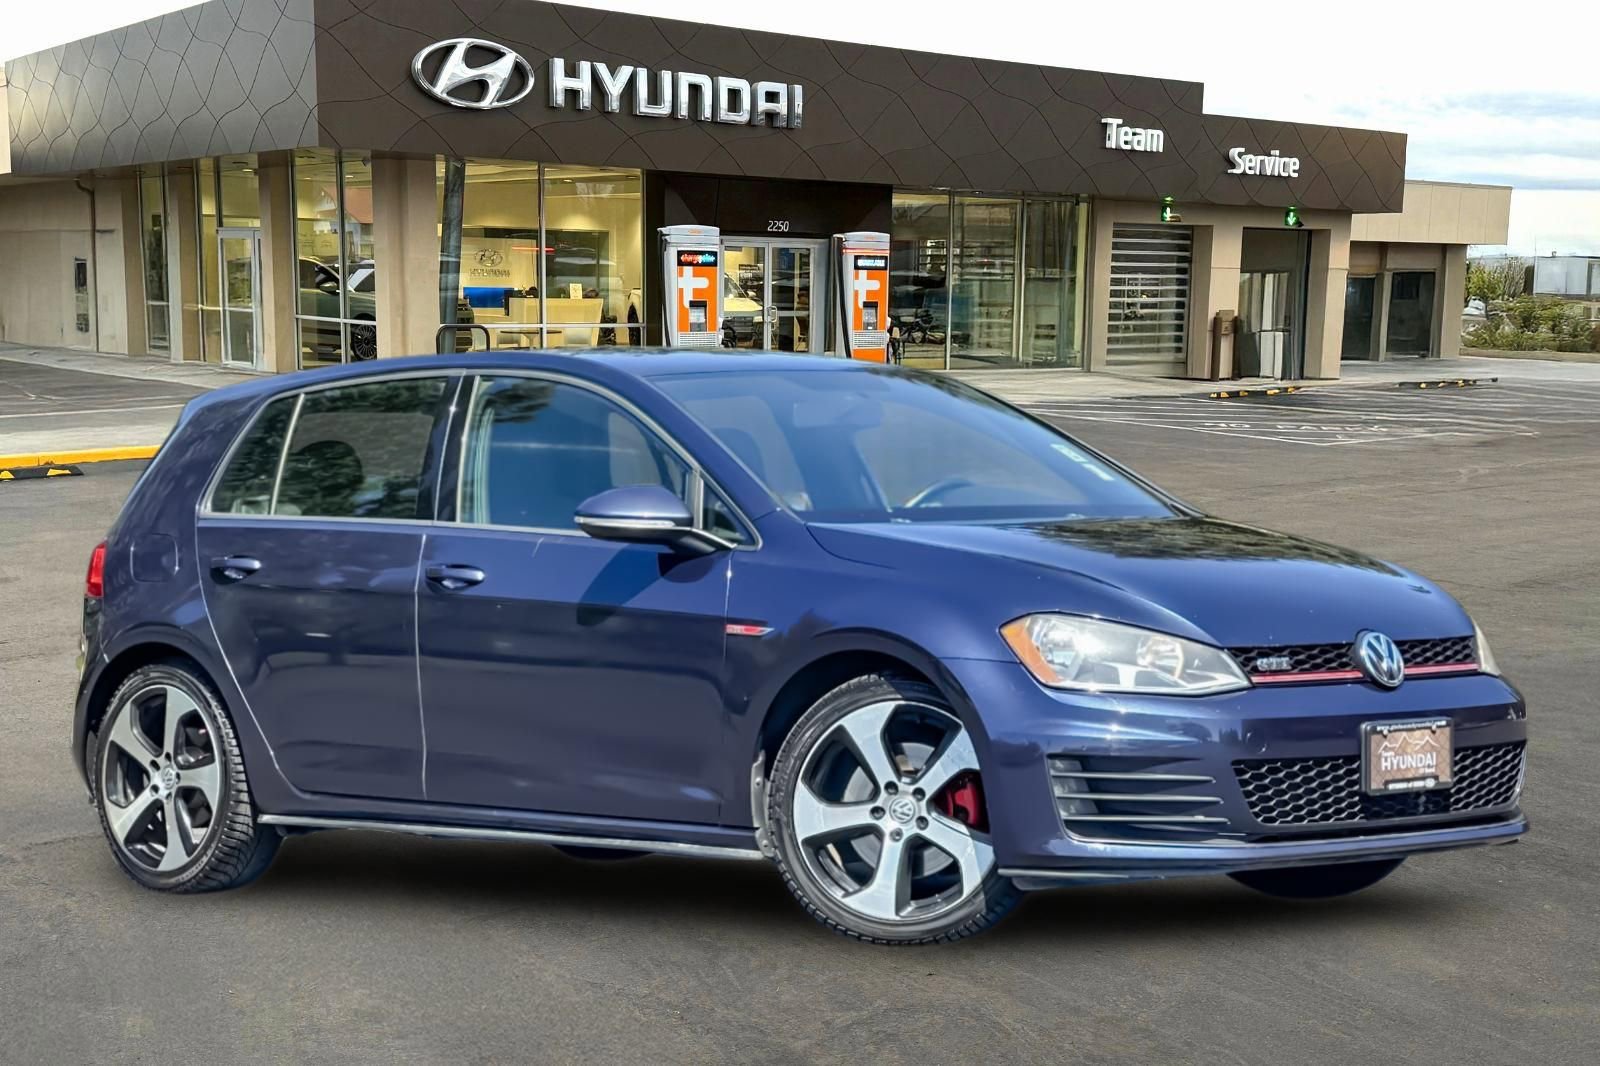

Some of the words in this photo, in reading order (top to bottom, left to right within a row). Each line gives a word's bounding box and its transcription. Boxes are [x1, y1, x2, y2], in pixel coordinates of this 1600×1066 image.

[549, 57, 803, 129] HYUNDAI
[1101, 117, 1164, 153] Team
[1227, 147, 1300, 178] Service
[767, 220, 790, 232] 2250
[1381, 751, 1437, 772] HYUNDAI
